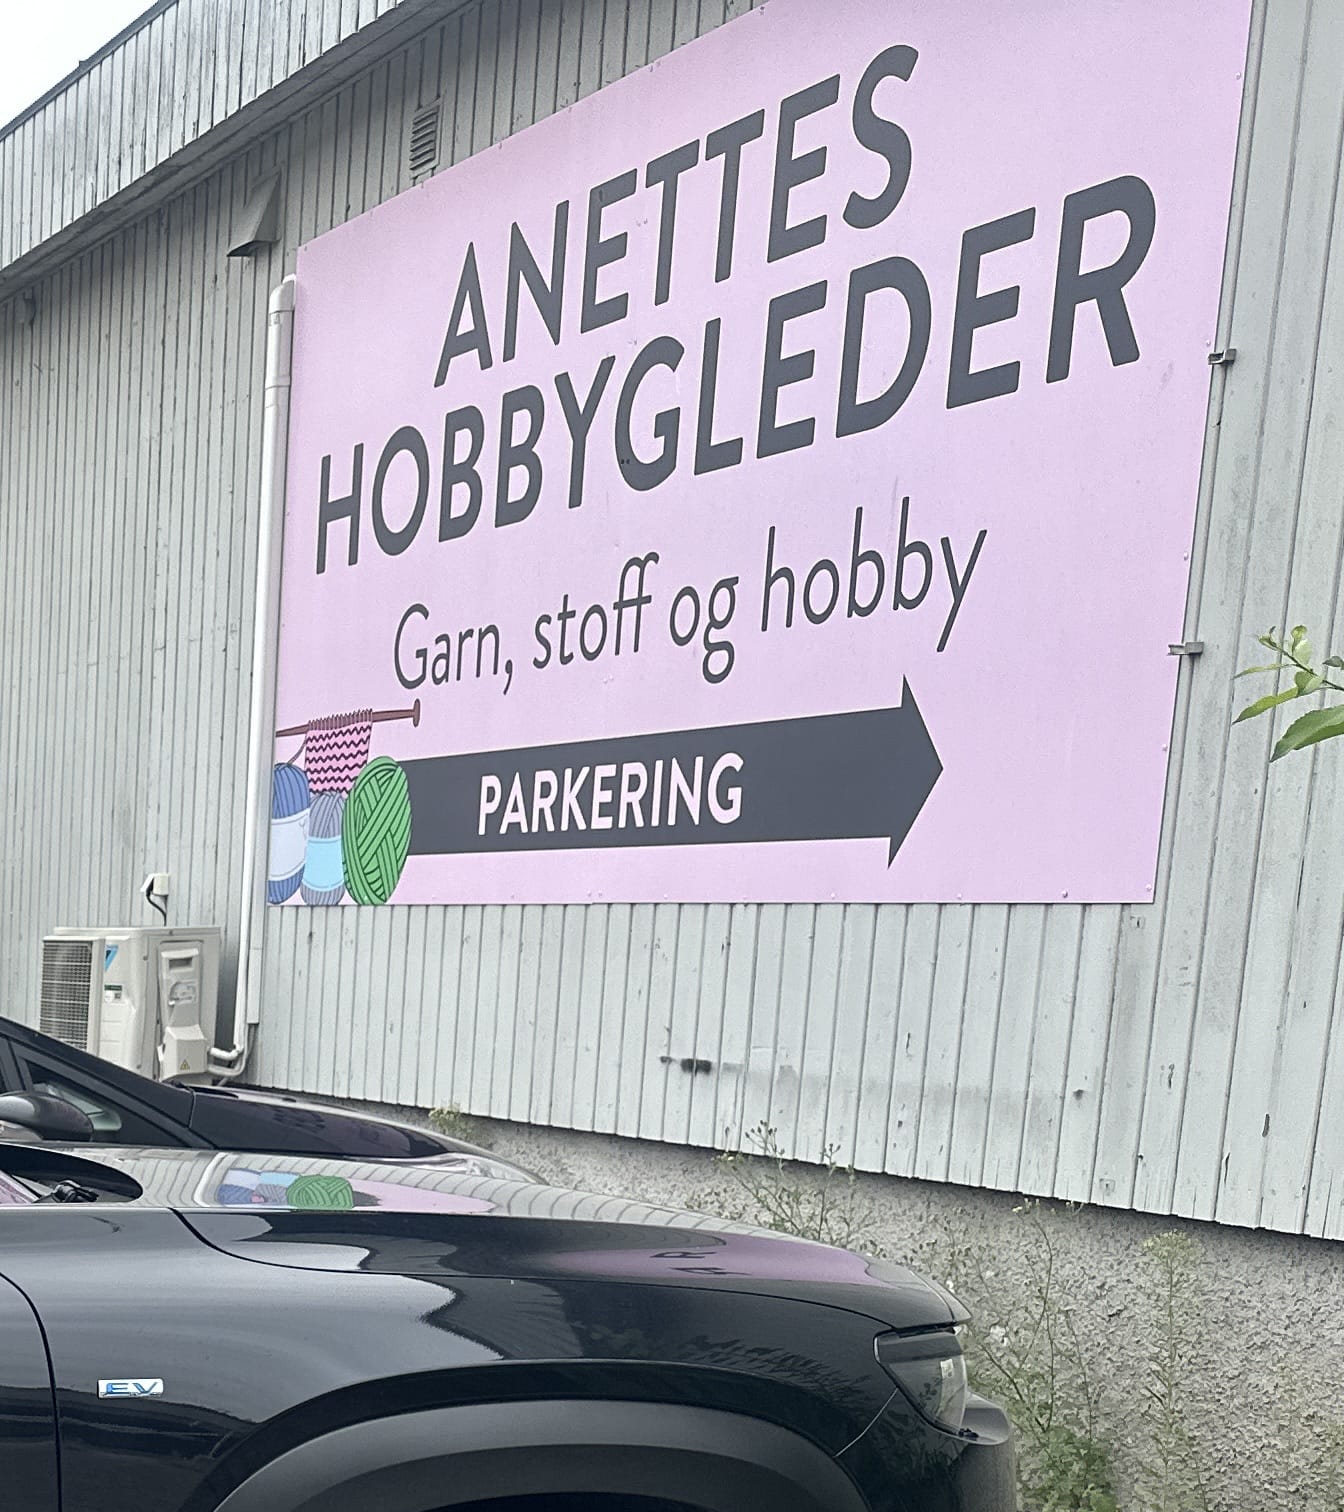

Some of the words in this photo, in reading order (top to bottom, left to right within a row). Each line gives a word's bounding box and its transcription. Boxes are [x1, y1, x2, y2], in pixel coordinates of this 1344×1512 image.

[433, 44, 919, 388] ANETTES
[316, 175, 1157, 575] HOBBYGLEDER
[394, 603, 514, 698] Garn,
[532, 551, 660, 669] stoff
[669, 575, 740, 684] og
[761, 496, 988, 653] hobby
[477, 752, 744, 836] PARKERING
[105, 1381, 159, 1395] EV
